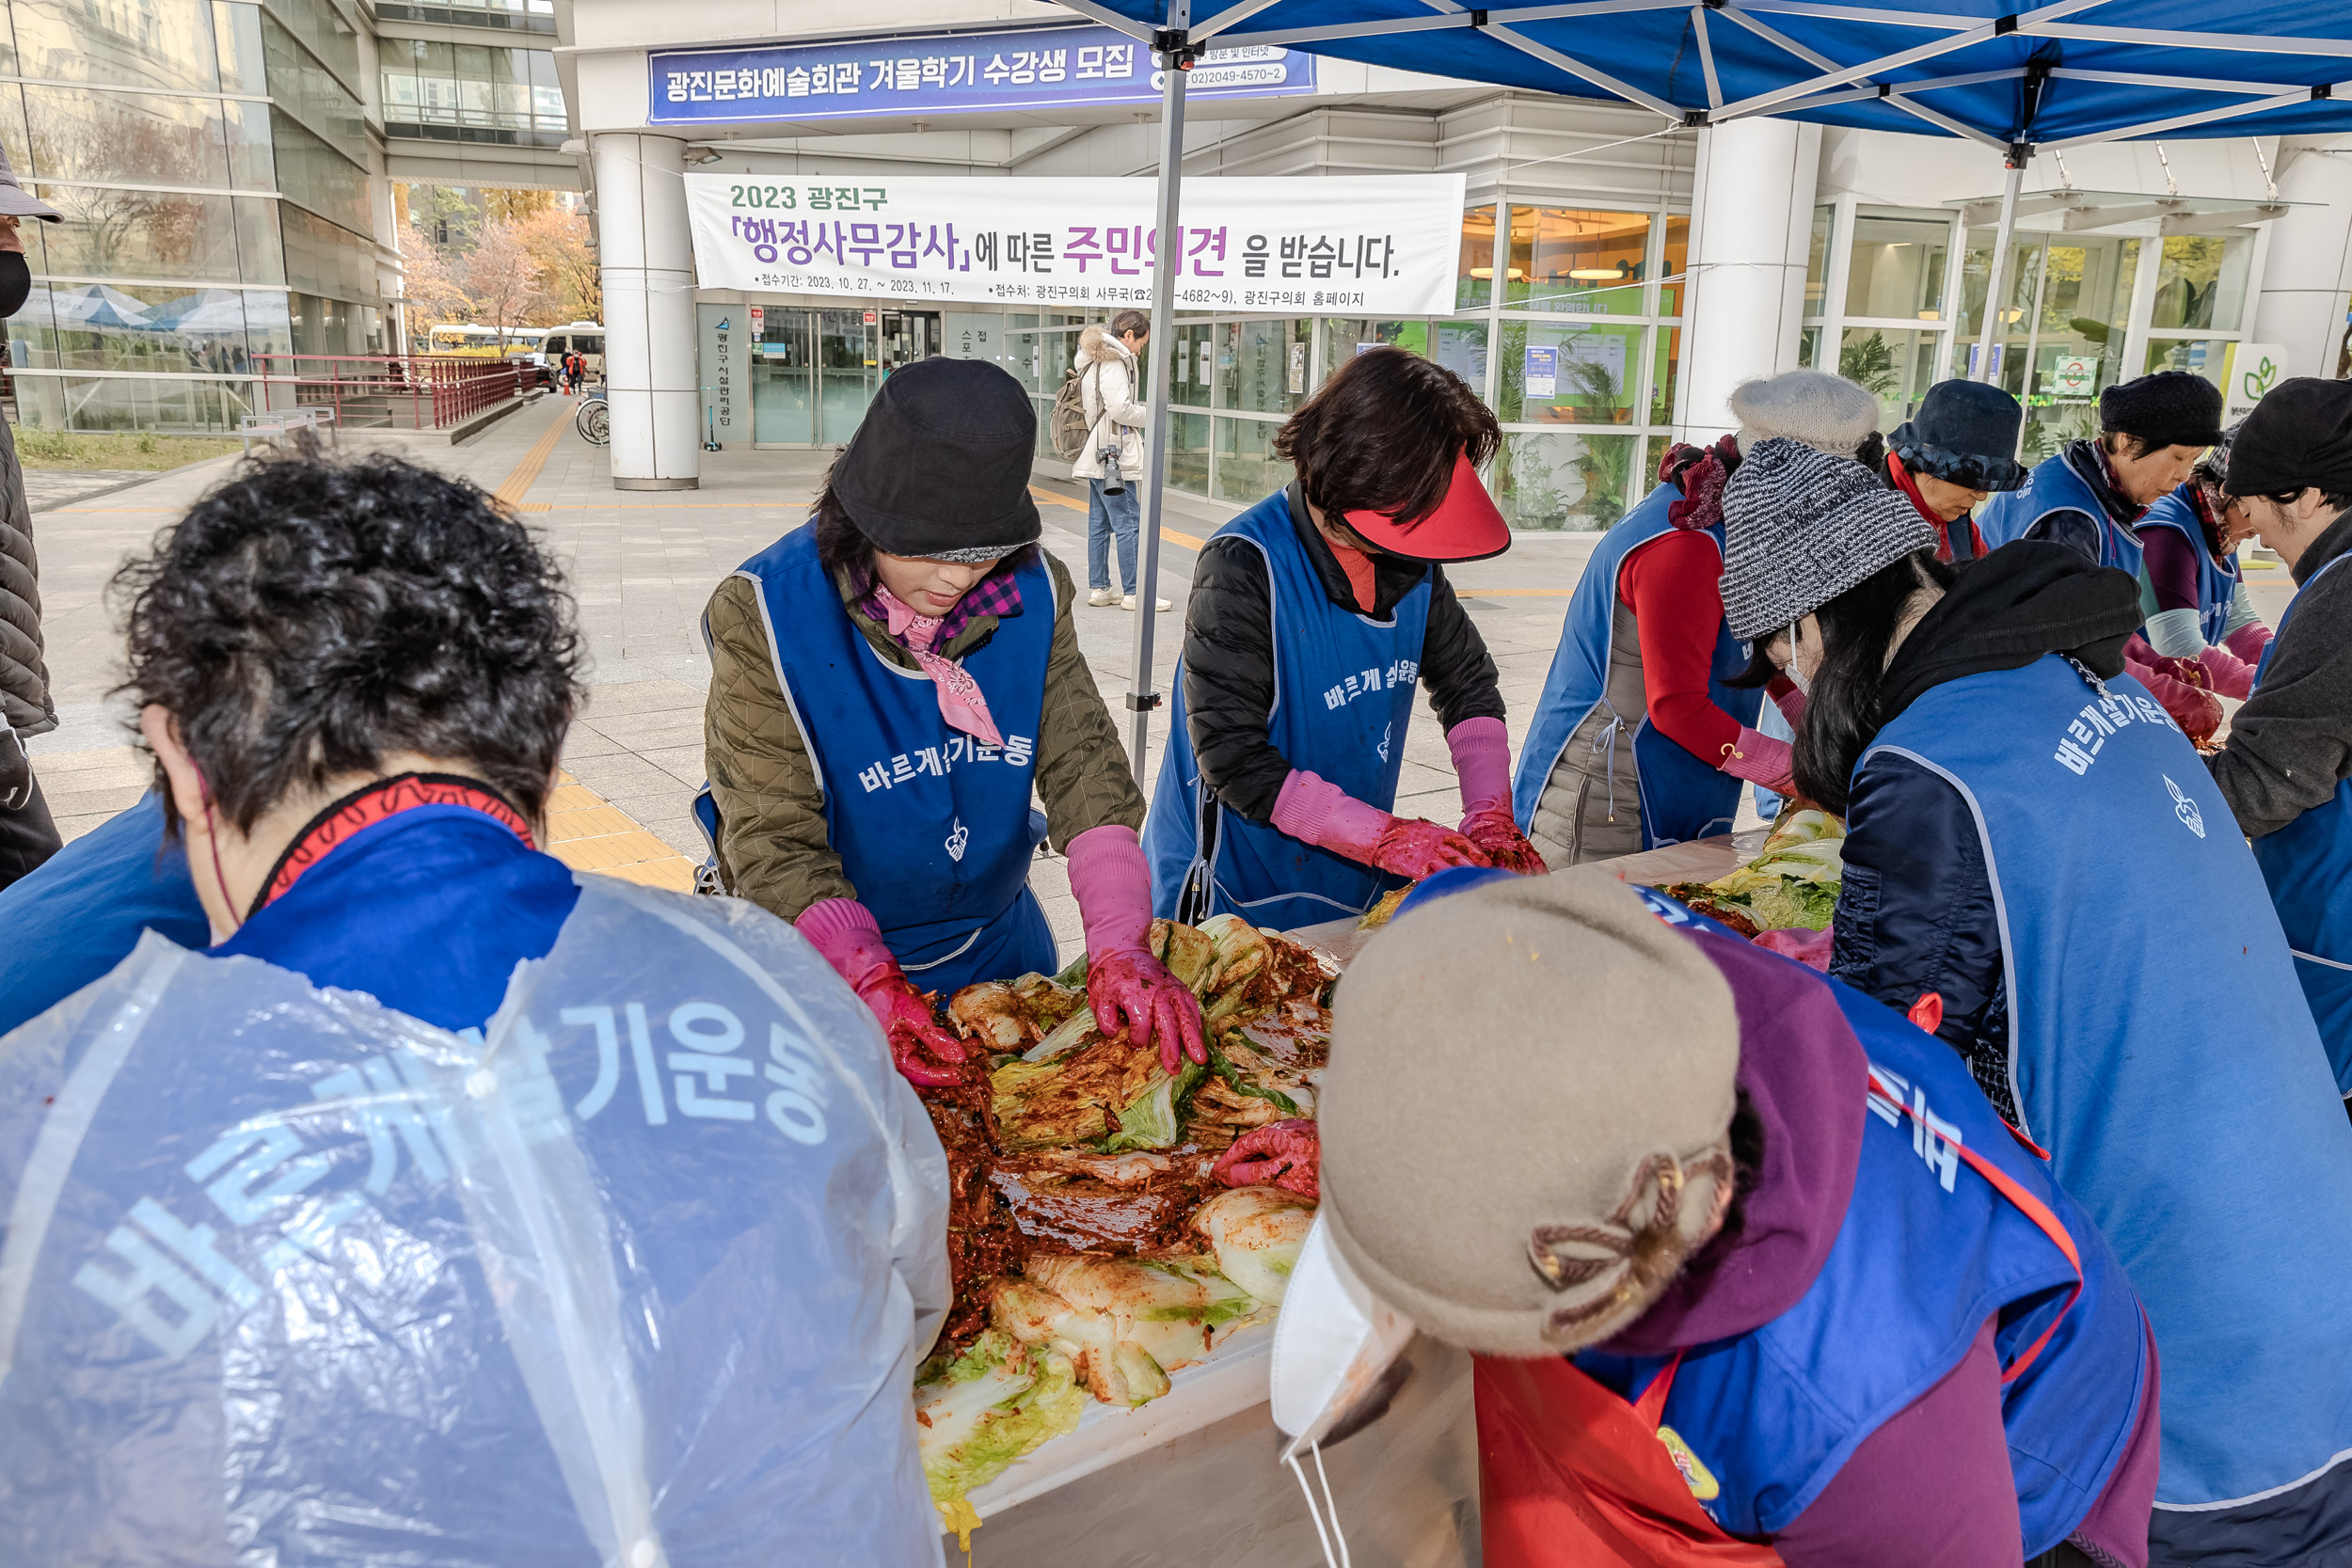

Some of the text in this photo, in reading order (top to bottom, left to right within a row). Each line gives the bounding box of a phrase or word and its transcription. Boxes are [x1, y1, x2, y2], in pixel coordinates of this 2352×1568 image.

[666, 43, 1134, 103] 광진문화예술회관 겨울학기 수강생 모집
[730, 184, 888, 212] 2023 광진구
[1007, 232, 1056, 274] 따른
[1242, 234, 1270, 278] 을
[1279, 234, 1400, 279] 받습니다.
[807, 276, 834, 290] 2023.
[839, 277, 852, 291] 10.
[858, 277, 871, 291] 27.
[890, 279, 917, 293] 2023.
[923, 281, 935, 294] 11.
[941, 282, 954, 295] 17.
[1036, 285, 1089, 300] 광진구의회
[1245, 291, 1306, 306] 광진구의회
[1312, 292, 1364, 307] 홈페이지
